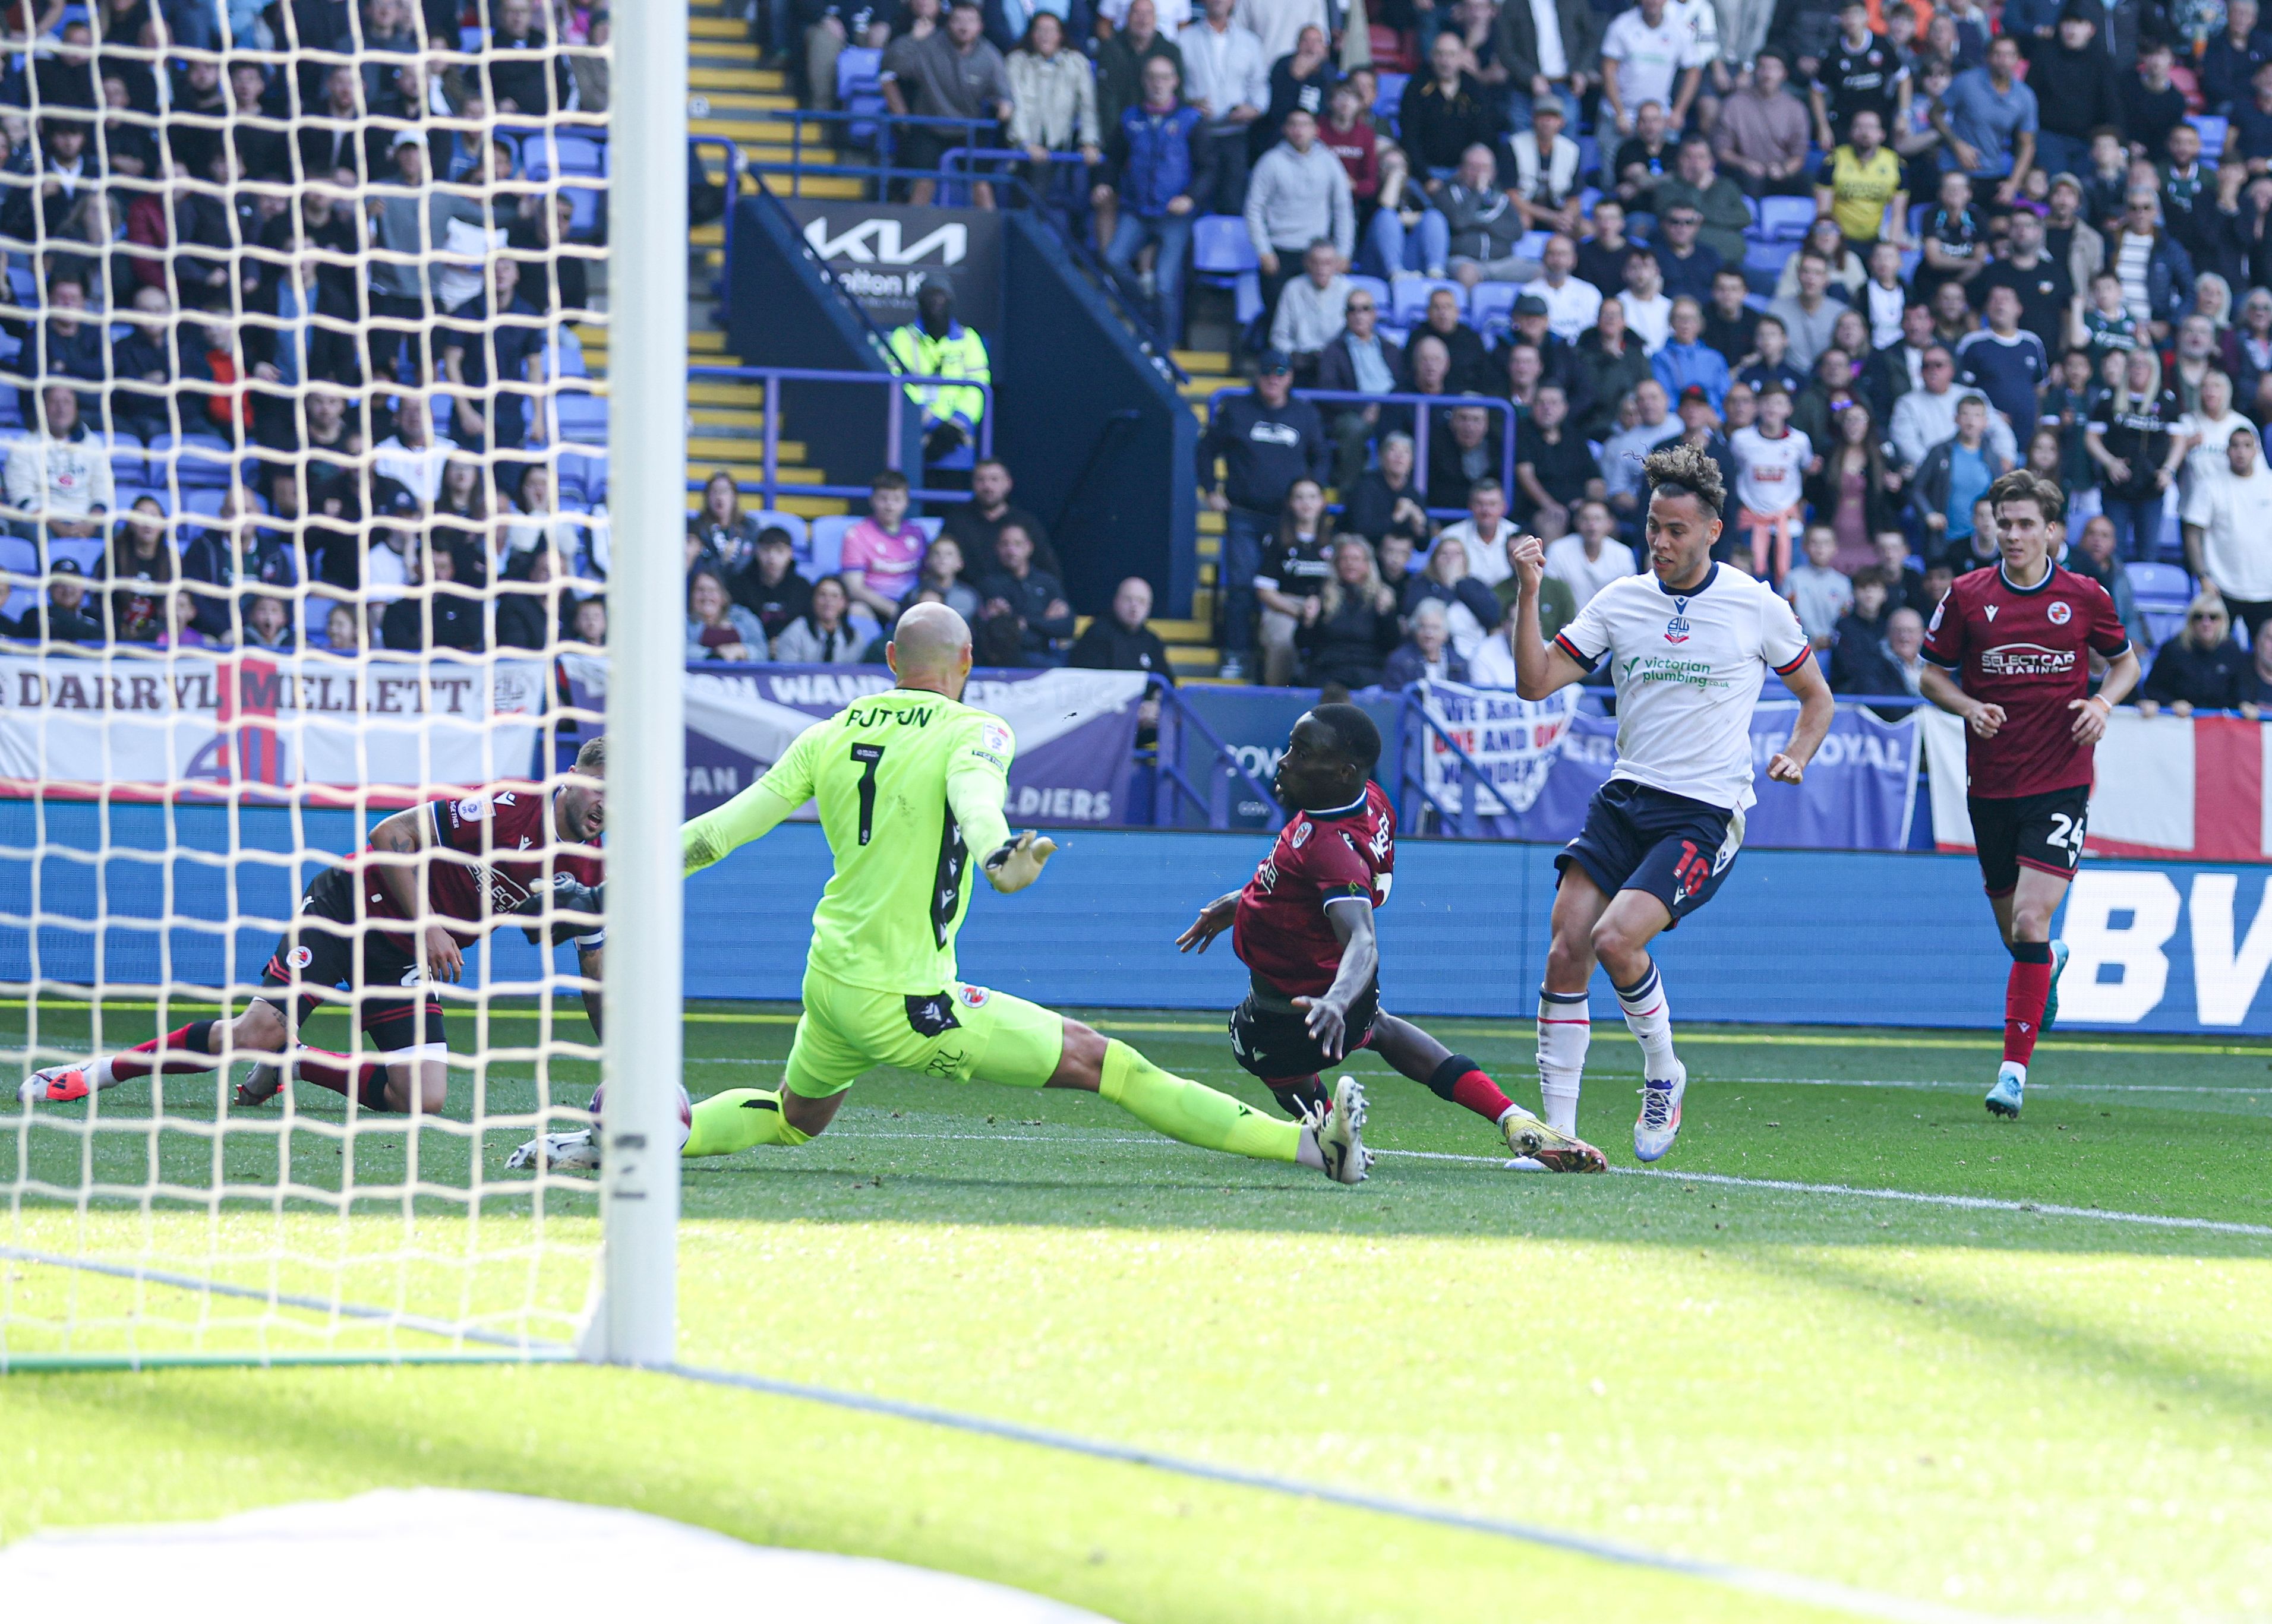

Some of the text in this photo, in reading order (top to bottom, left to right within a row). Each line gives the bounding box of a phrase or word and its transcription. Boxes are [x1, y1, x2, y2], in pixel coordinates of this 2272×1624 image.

[803, 216, 968, 267] KIA
[1643, 669, 1731, 688] plumbing.co.uk
[1645, 656, 1711, 674] victorian
[1981, 654, 2039, 668] SELECT
[1997, 665, 2060, 675] LEASING
[18, 670, 223, 710] DARRYL
[239, 671, 472, 713] MELLETT
[1807, 732, 1908, 772] OYAL
[1004, 785, 1112, 820] LDIERS
[2046, 812, 2084, 854] 24
[1673, 839, 1709, 897] 10
